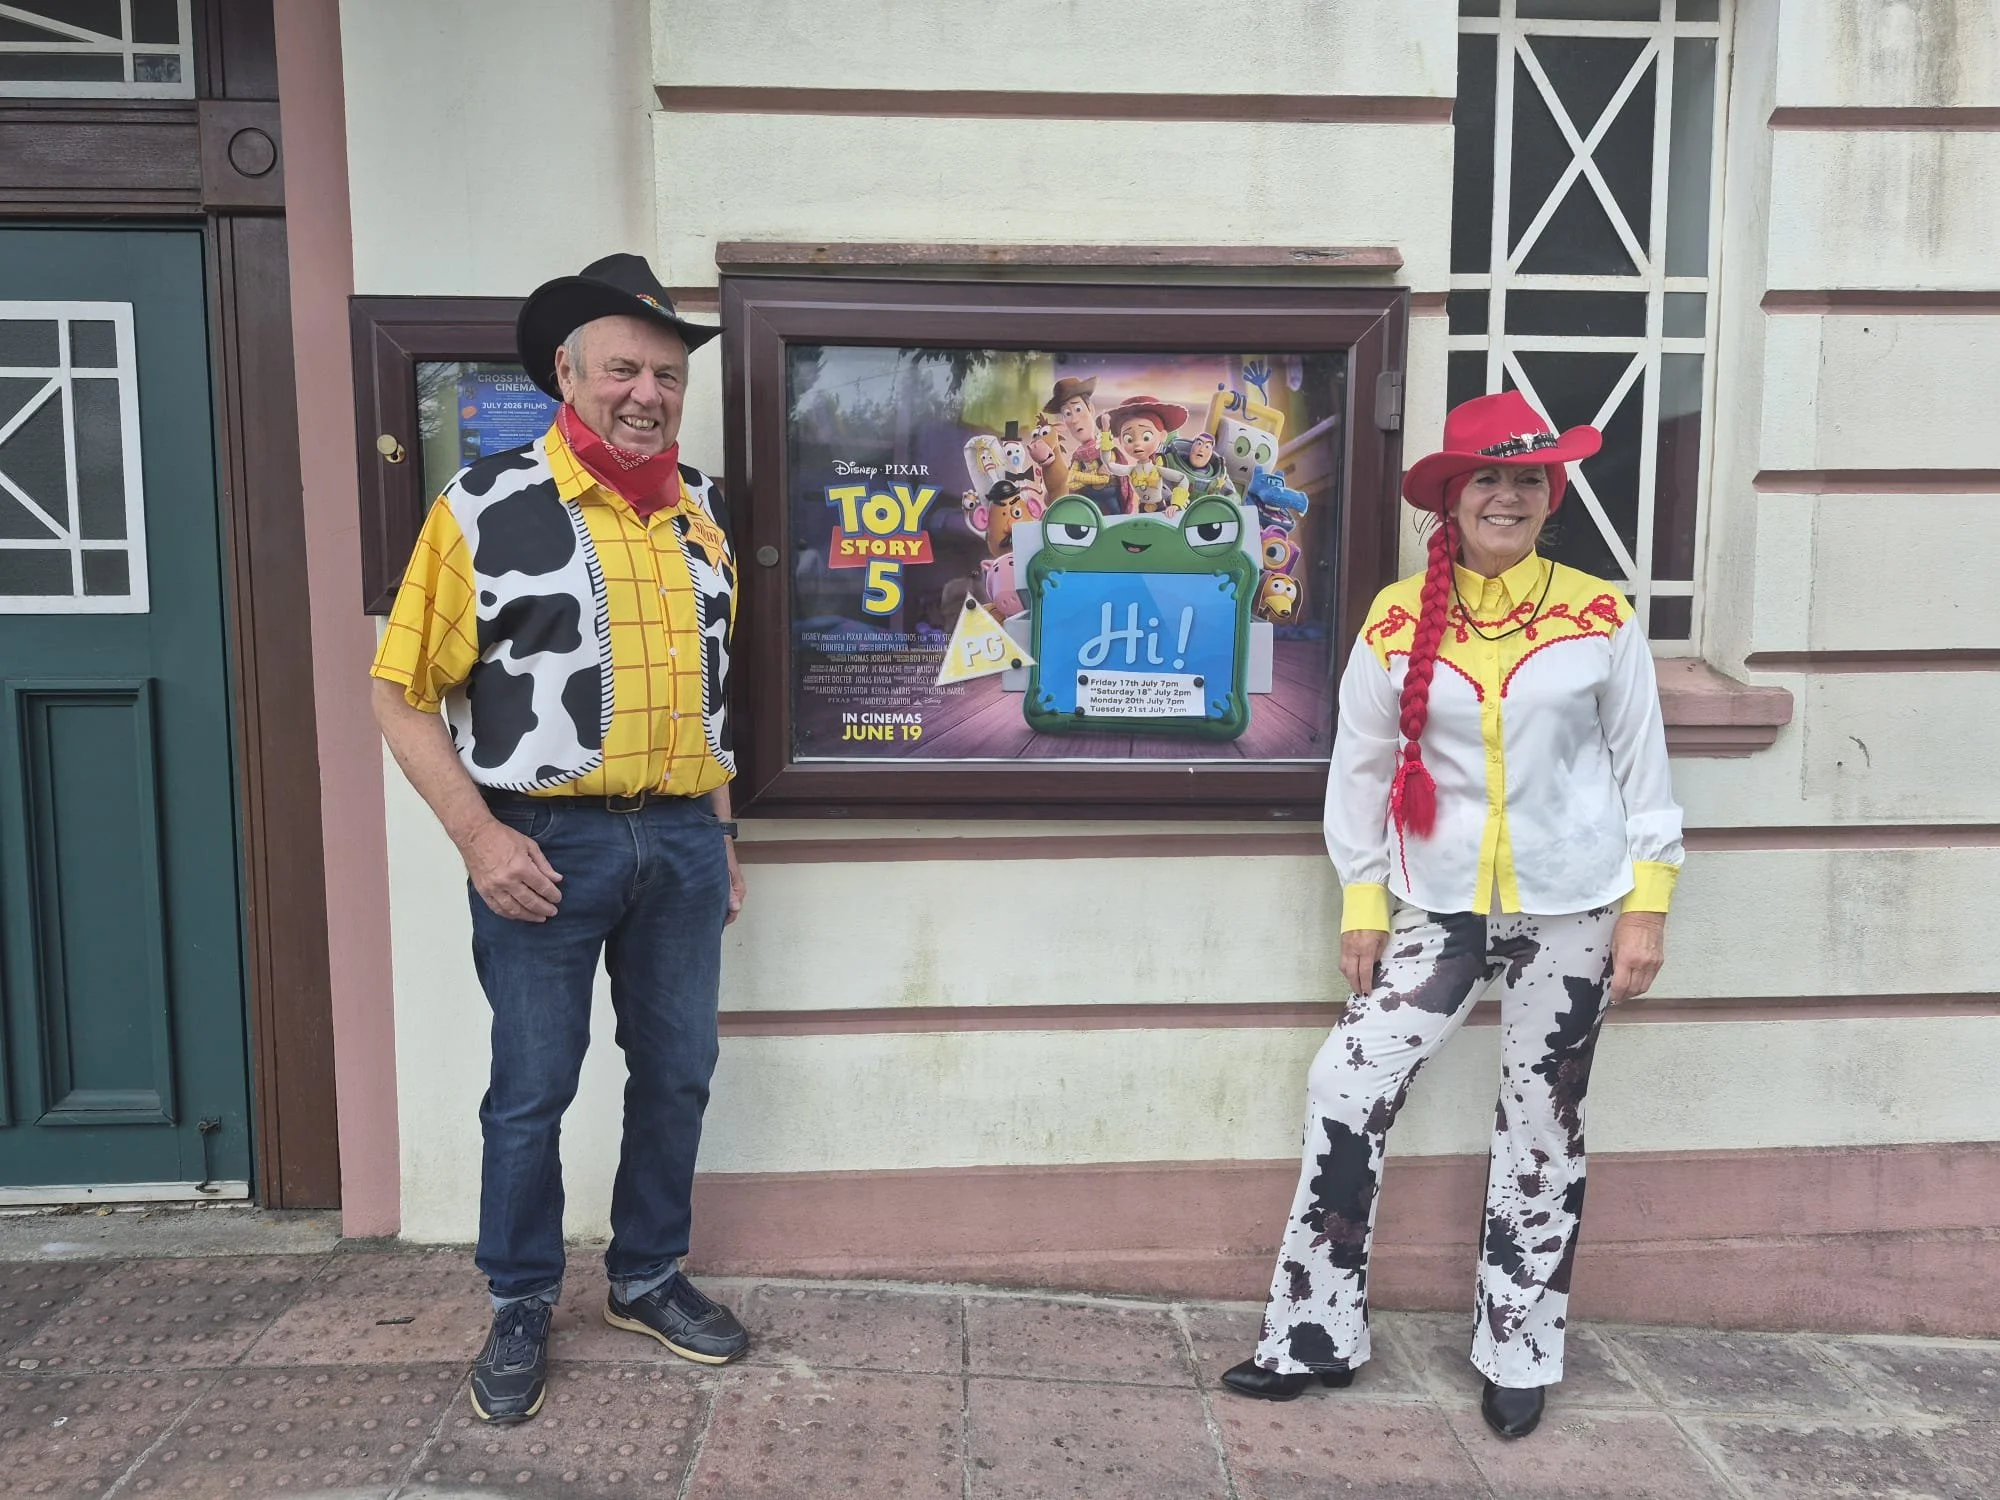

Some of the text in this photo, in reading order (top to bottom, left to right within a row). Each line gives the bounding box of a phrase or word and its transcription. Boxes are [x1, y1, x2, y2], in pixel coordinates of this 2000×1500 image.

[478, 374, 512, 382] CROSS
[495, 383, 536, 392] CINEMA
[832, 460, 930, 479] Disney PIXAR
[826, 483, 939, 536] TOY
[840, 539, 924, 556] STORY
[864, 559, 902, 614] 5
[895, 633, 916, 641] STUDIOS
[1078, 602, 1194, 670] Hi!
[962, 632, 1005, 667] PG
[848, 654, 869, 662] THOMAS
[1090, 679, 1117, 687] Friday
[844, 686, 868, 694] STANTON
[842, 713, 922, 723] IN CINEMAS
[842, 725, 922, 740] JUNE 19
